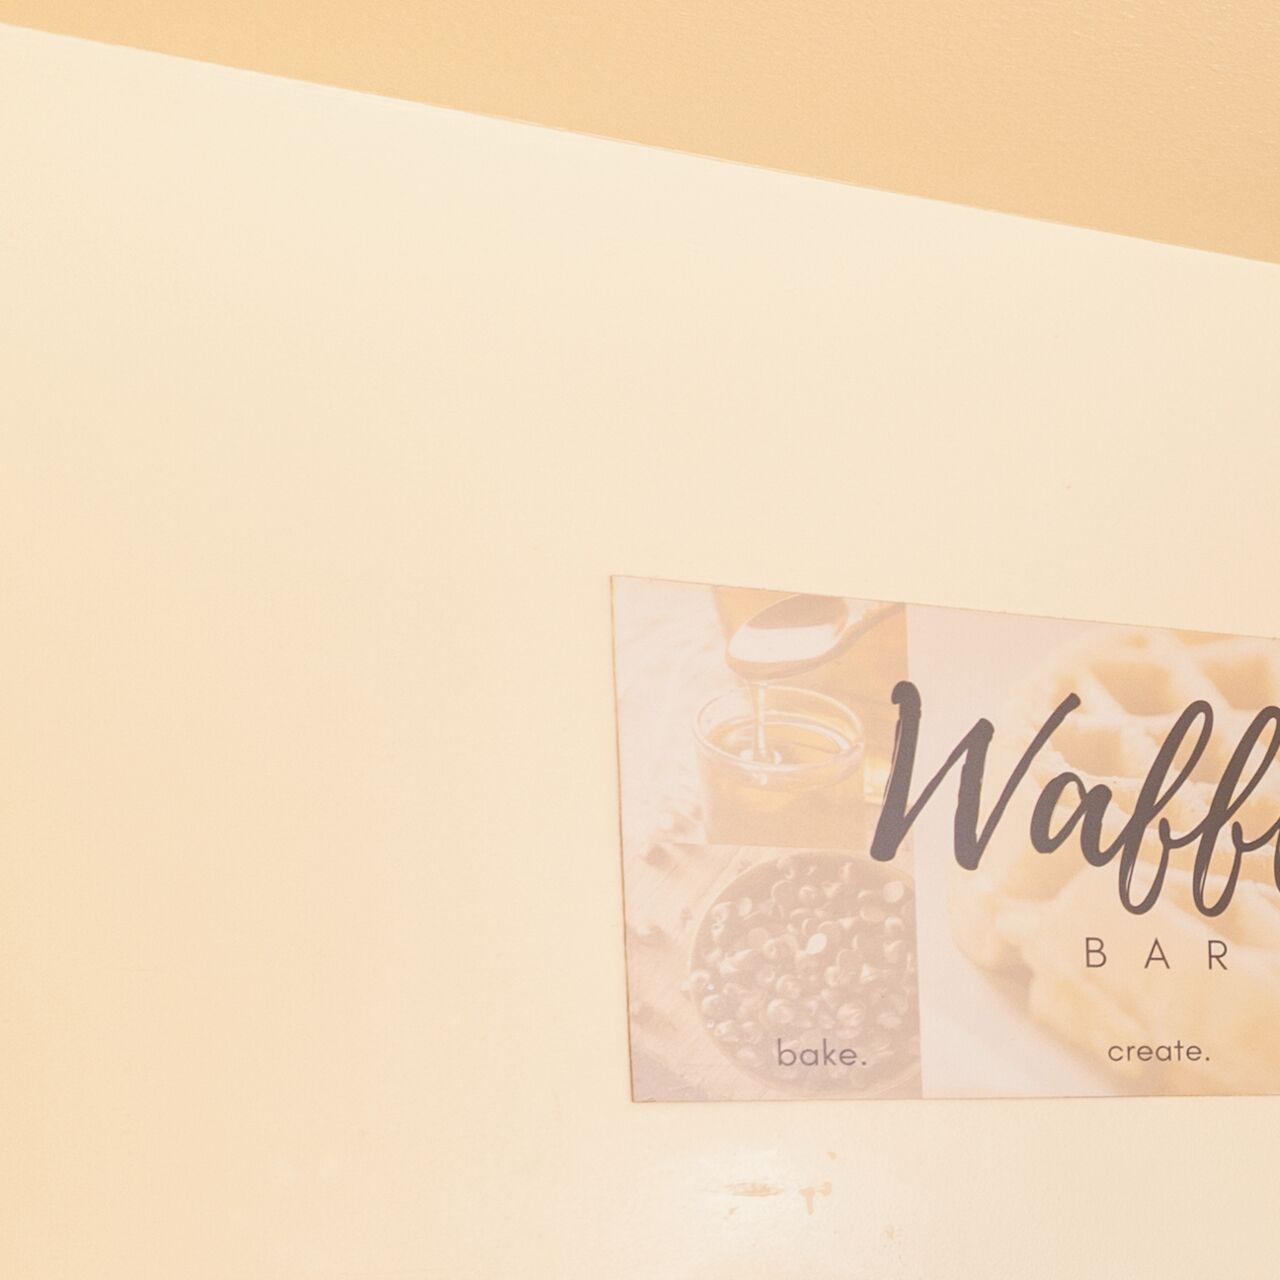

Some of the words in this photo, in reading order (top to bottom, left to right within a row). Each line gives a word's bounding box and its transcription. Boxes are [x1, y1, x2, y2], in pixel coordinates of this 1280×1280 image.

[1085, 937, 1229, 970] BAR
[777, 1037, 867, 1067] bake.
[1107, 1039, 1211, 1062] create.
